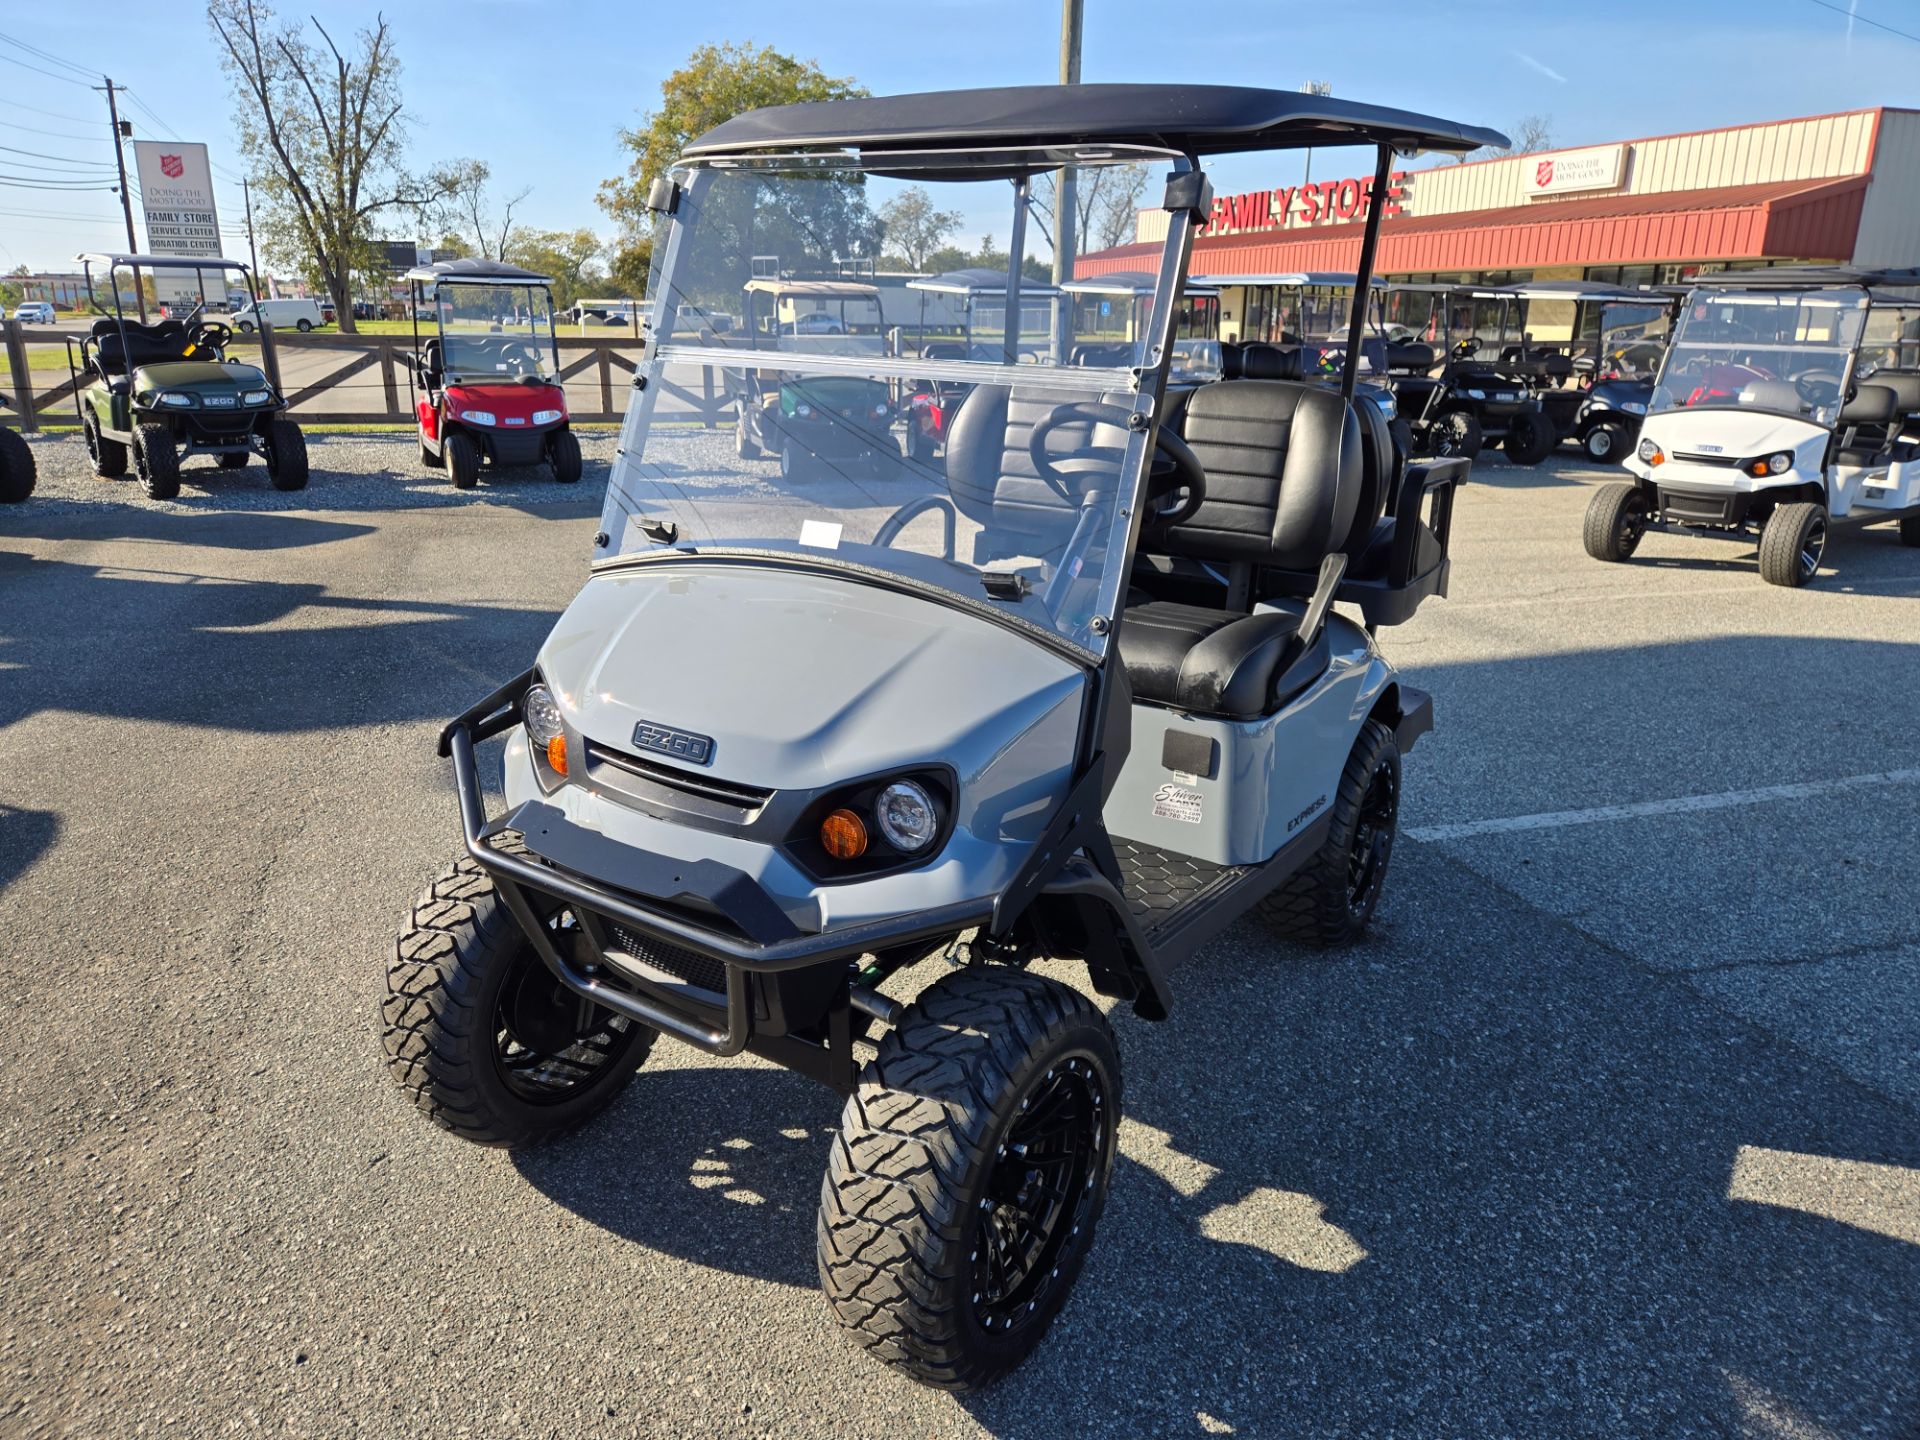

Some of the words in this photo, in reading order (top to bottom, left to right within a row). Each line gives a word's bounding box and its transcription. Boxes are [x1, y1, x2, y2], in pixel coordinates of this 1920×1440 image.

[150, 187, 183, 197] DOING
[184, 189, 202, 198] THE
[149, 197, 176, 205] MOST
[178, 198, 206, 207] GOOD
[1205, 187, 1296, 233] FAMILY
[1300, 171, 1406, 222] STORE
[147, 212, 180, 223] FAMILY
[184, 213, 213, 224] STORE
[151, 226, 181, 236] SERVICE
[184, 227, 214, 237] CENTER
[150, 239, 188, 249] DONATION
[190, 240, 218, 250] CENTER
[634, 724, 708, 760] EZGO
[1155, 785, 1202, 802] Shiver
[1287, 794, 1328, 833] EXPRESS
